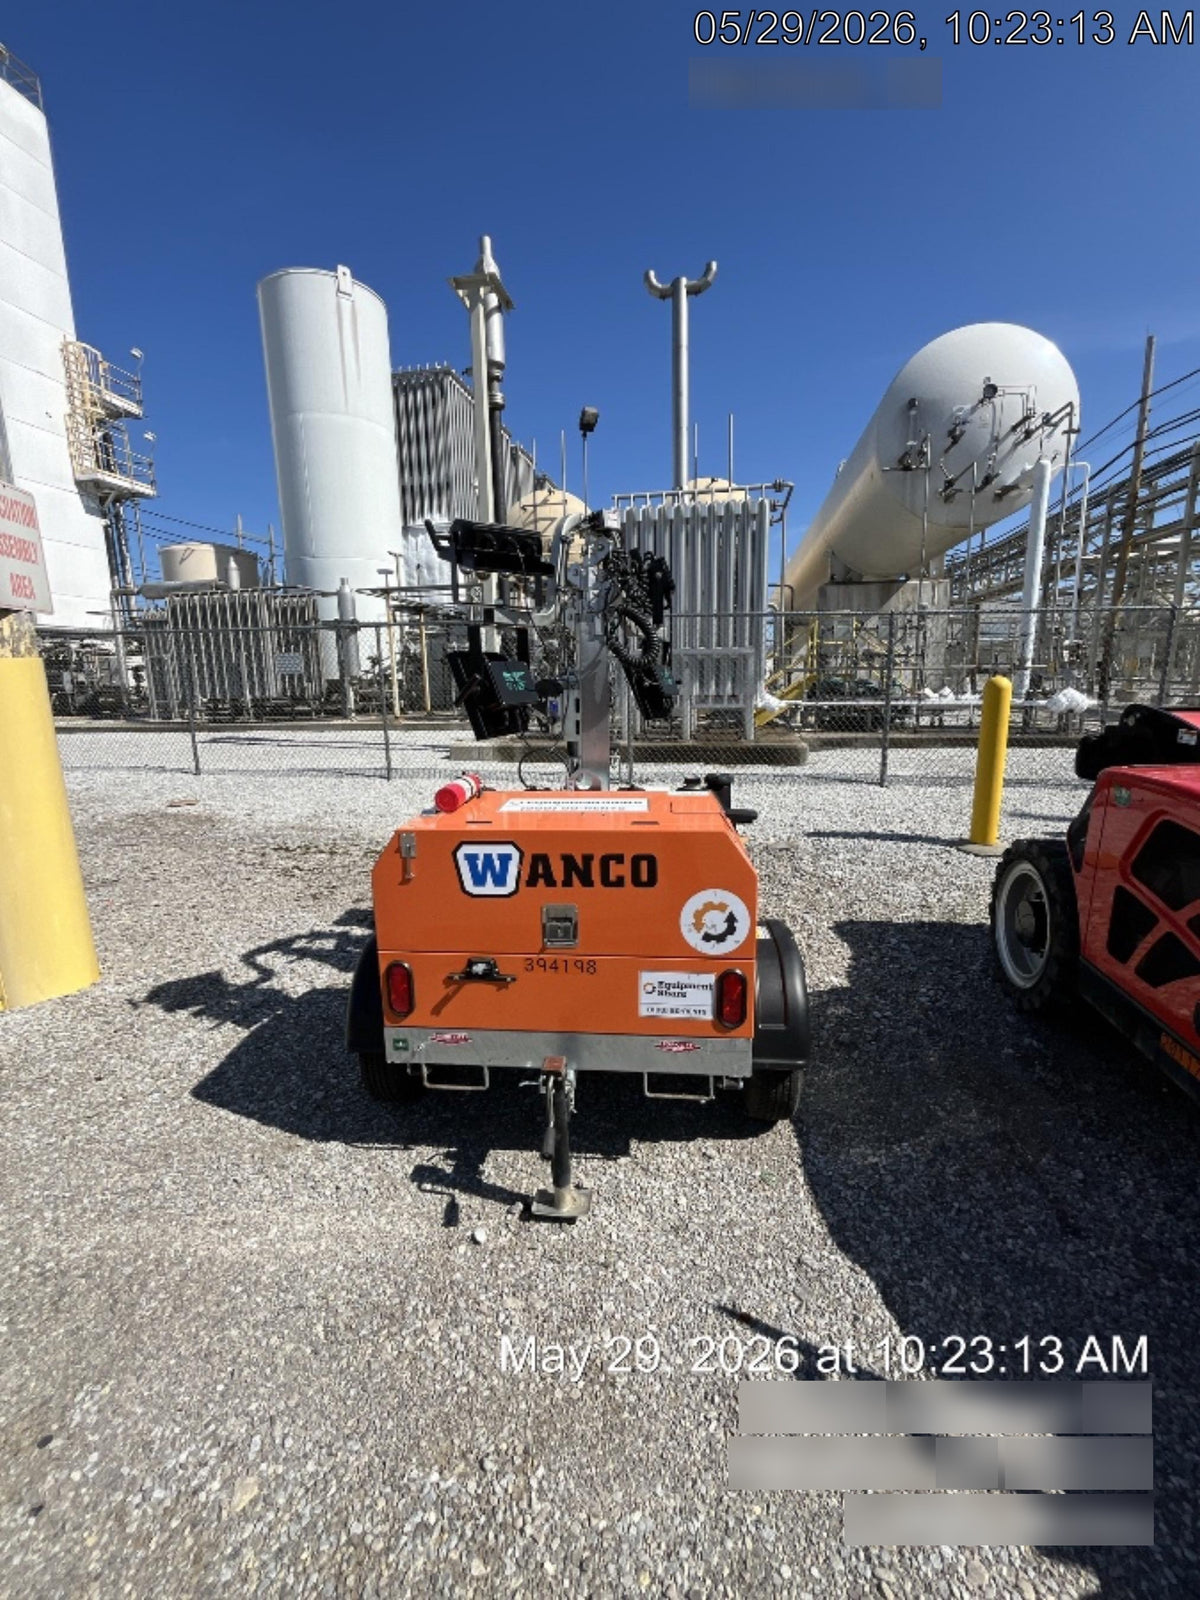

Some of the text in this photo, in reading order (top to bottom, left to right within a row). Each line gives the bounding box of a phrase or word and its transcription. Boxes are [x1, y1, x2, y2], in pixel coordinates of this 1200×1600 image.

[10, 572, 36, 600] AREA
[463, 852, 658, 888] WANCO
[524, 957, 597, 975] 394198
